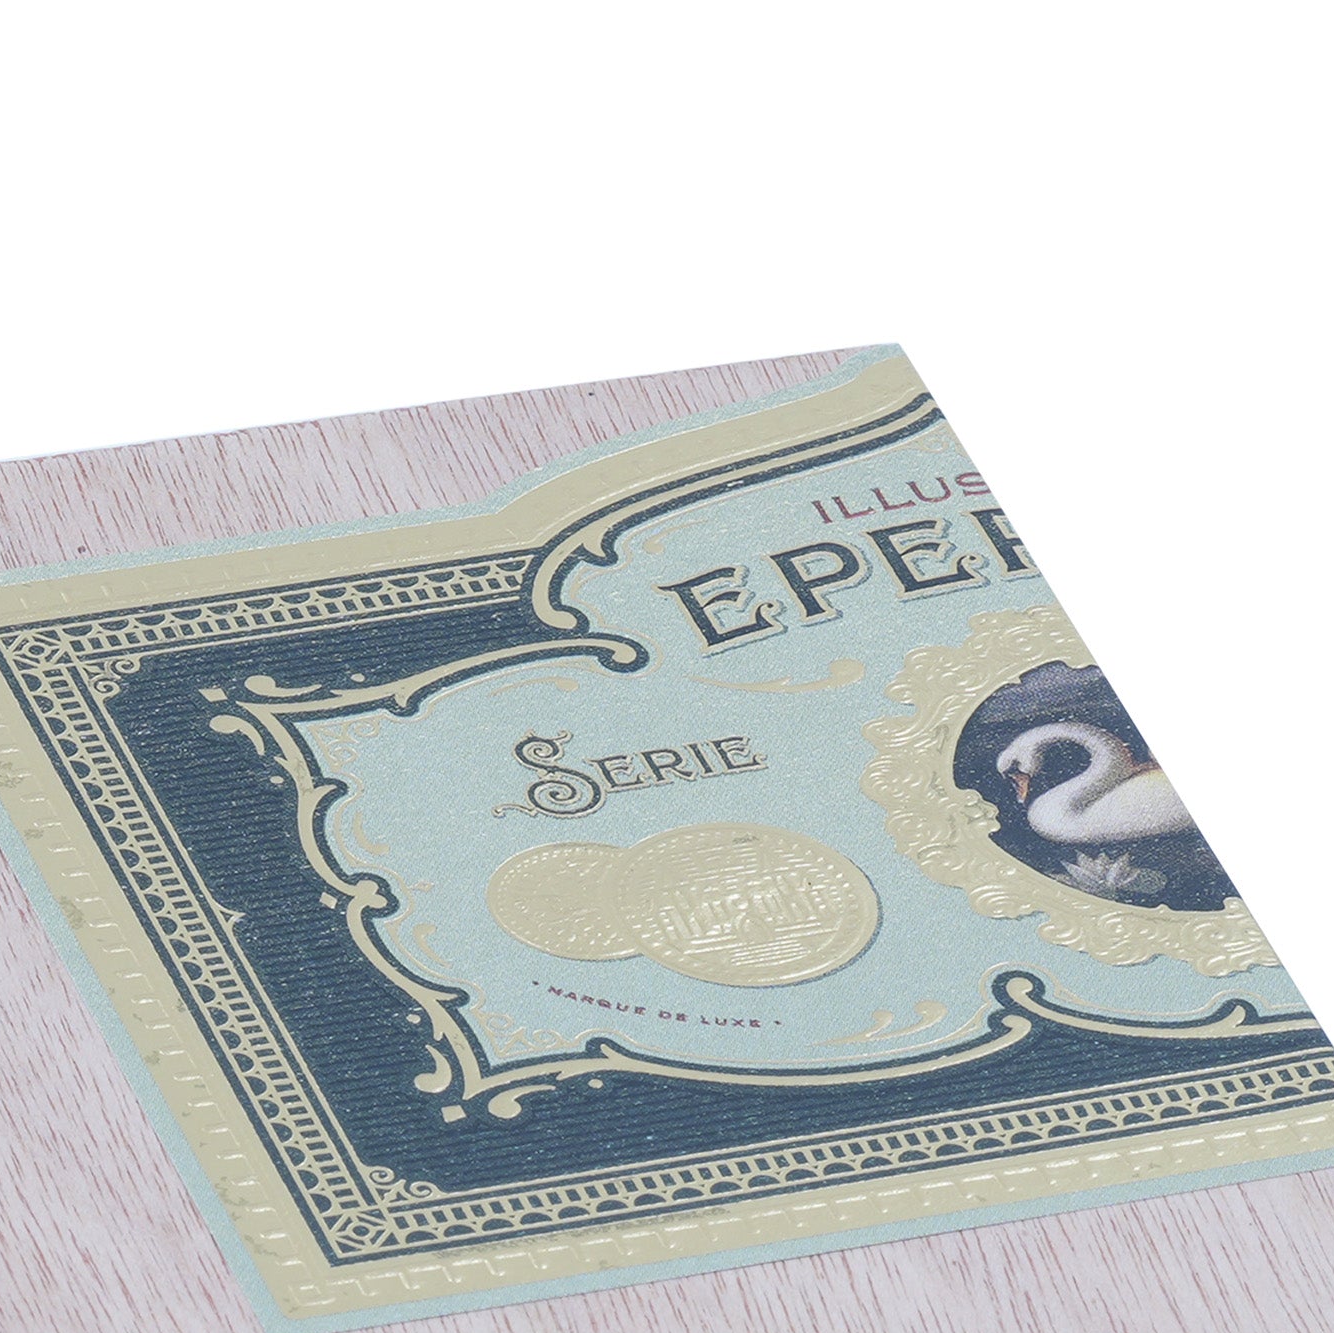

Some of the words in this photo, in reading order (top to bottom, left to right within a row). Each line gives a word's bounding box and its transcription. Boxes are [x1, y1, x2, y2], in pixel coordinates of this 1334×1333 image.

[548, 985, 647, 1016] MARQUE
[657, 1010, 689, 1024] DE
[700, 1013, 762, 1029] LUXE
